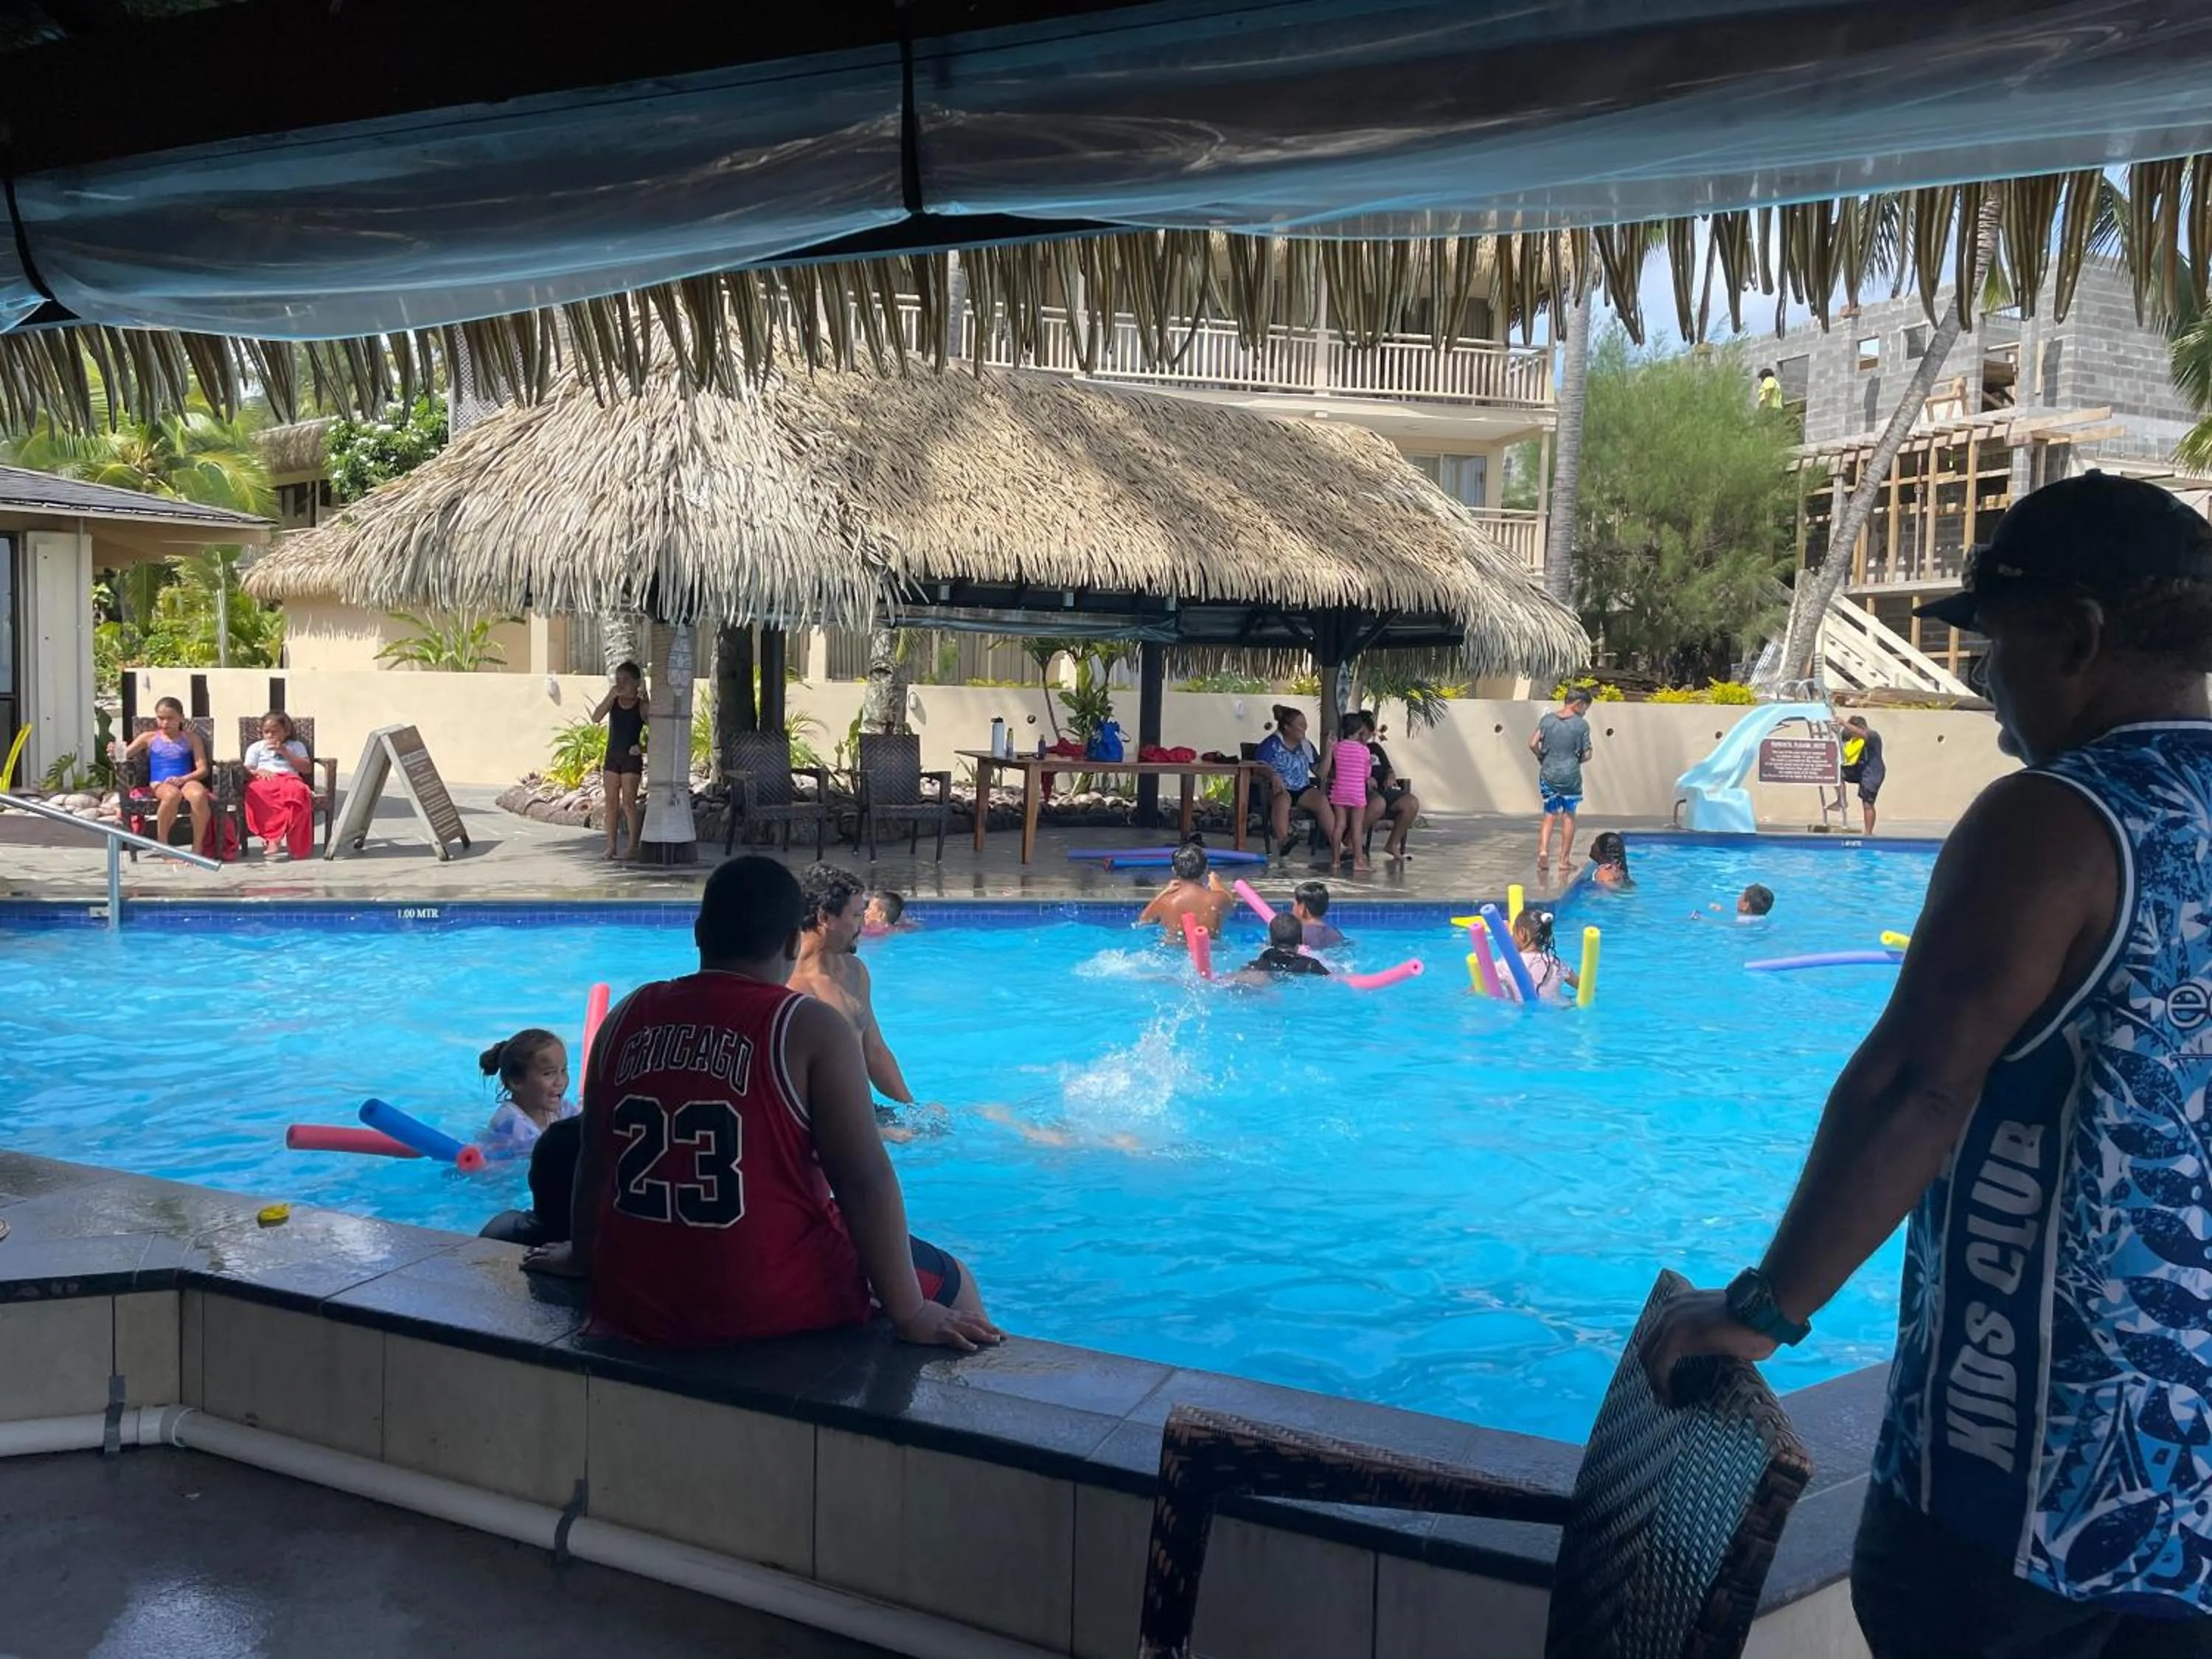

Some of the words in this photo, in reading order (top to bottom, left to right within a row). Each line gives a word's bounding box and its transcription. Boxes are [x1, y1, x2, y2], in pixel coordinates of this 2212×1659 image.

[397, 908, 415, 919] 1.00
[417, 908, 439, 918] MTR
[614, 1024, 754, 1096] CHICAGO
[613, 1094, 745, 1228] 23
[1965, 1119, 2045, 1295] CLUB
[1946, 1301, 2018, 1473] KIDS
